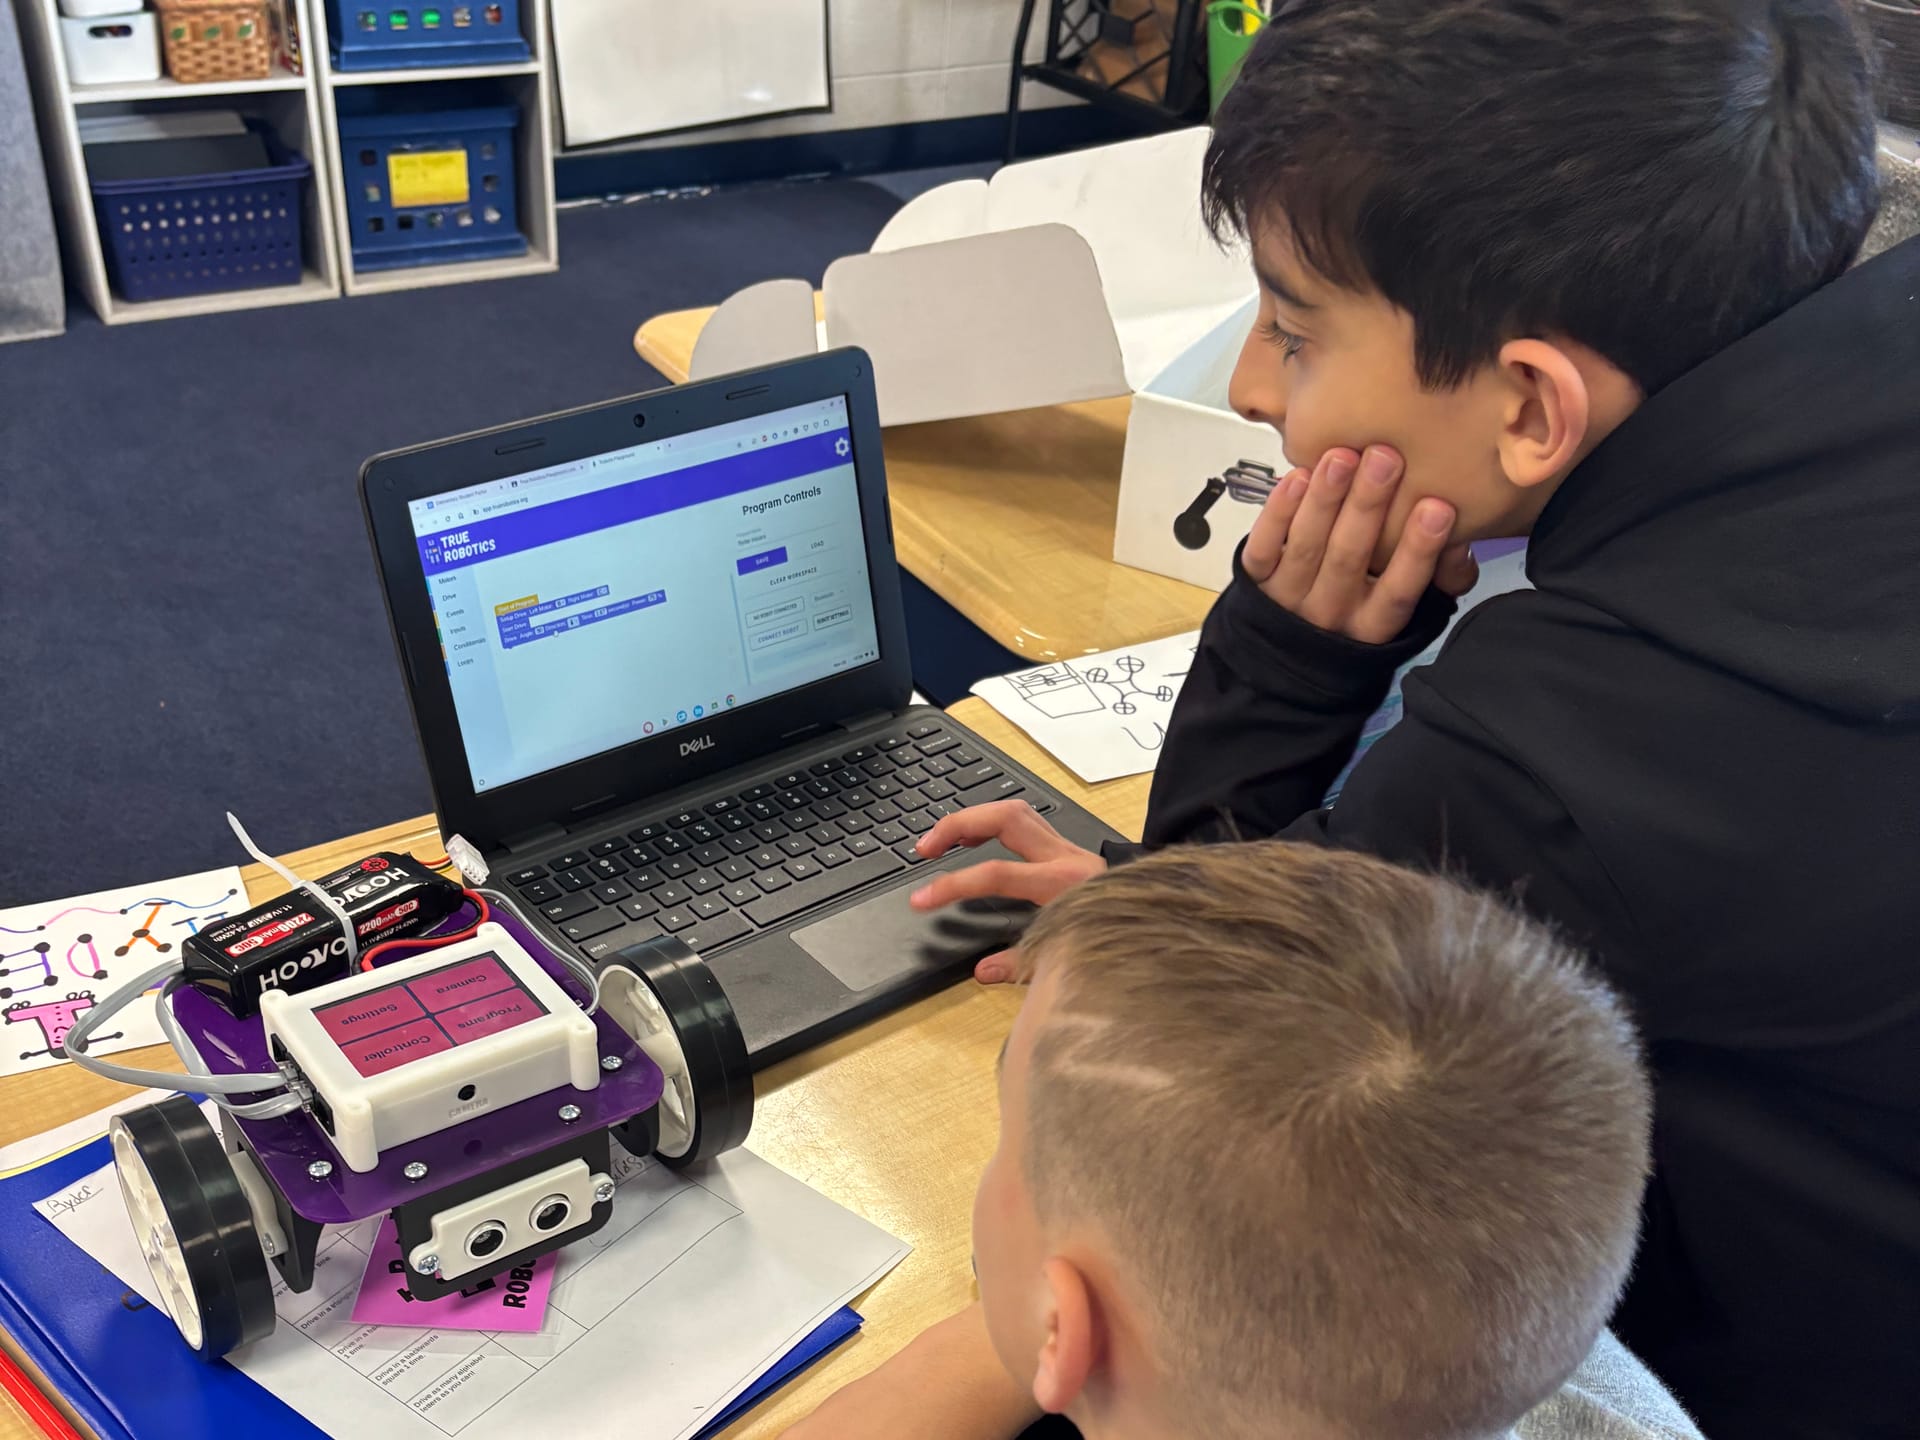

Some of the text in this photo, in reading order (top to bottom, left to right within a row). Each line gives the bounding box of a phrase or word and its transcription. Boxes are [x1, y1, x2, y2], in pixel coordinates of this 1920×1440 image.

[742, 486, 822, 516] Program Controls
[440, 531, 470, 548] TRUE
[811, 540, 824, 550] LOAD
[444, 539, 496, 563] ROBOTICS
[755, 556, 769, 566] SAVE
[438, 576, 457, 585] Motors
[769, 567, 817, 586] CLEAR WORKSPACE
[442, 593, 457, 602] Drive
[446, 608, 464, 619] Events
[758, 630, 782, 644] CONNECT
[680, 734, 716, 756] DELL
[359, 902, 414, 935] 2200mAh 50C
[549, 906, 562, 915] tab
[260, 913, 314, 938] 2200mAh
[234, 938, 259, 952] 50C
[436, 974, 487, 995] Camera
[341, 1004, 398, 1025] Settings
[458, 1004, 522, 1030] Programs
[364, 1035, 431, 1062] Controller
[449, 1098, 488, 1118] CAMERA
[301, 1314, 320, 1330] Drive
[337, 1340, 354, 1356] Drive
[374, 1366, 394, 1382] Drive
[404, 1334, 439, 1361] backwards
[382, 1366, 404, 1386] square
[410, 1354, 426, 1366] time.
[413, 1354, 486, 1409] Drive as many alphabet
[420, 1396, 440, 1414] letters
[440, 1388, 450, 1398] as
[450, 1378, 462, 1392] you
